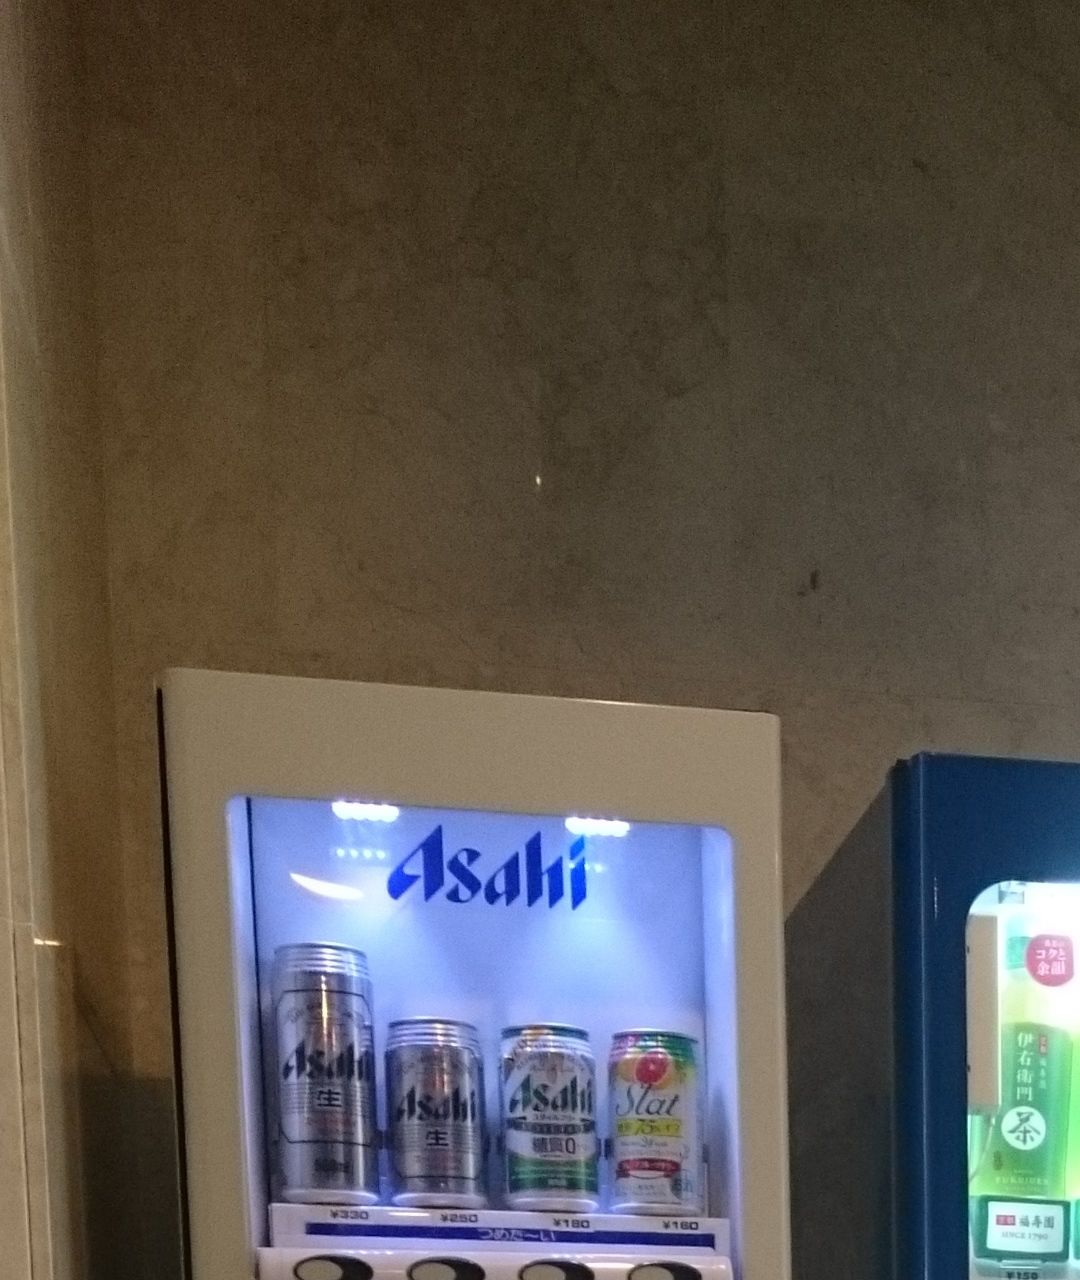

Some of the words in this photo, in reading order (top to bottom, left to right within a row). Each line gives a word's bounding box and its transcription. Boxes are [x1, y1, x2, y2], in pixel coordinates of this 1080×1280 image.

[387, 825, 588, 911] Asahi
[1016, 1032, 1034, 1101] 伊右衛門
[317, 1089, 342, 1108] 生
[509, 1073, 593, 1115] Asahi
[615, 1082, 679, 1117] Slat
[426, 1129, 449, 1147] 生
[1008, 1111, 1041, 1146] 茶
[330, 1209, 369, 1221] ¥330
[1007, 1271, 1039, 1280] ¥150
